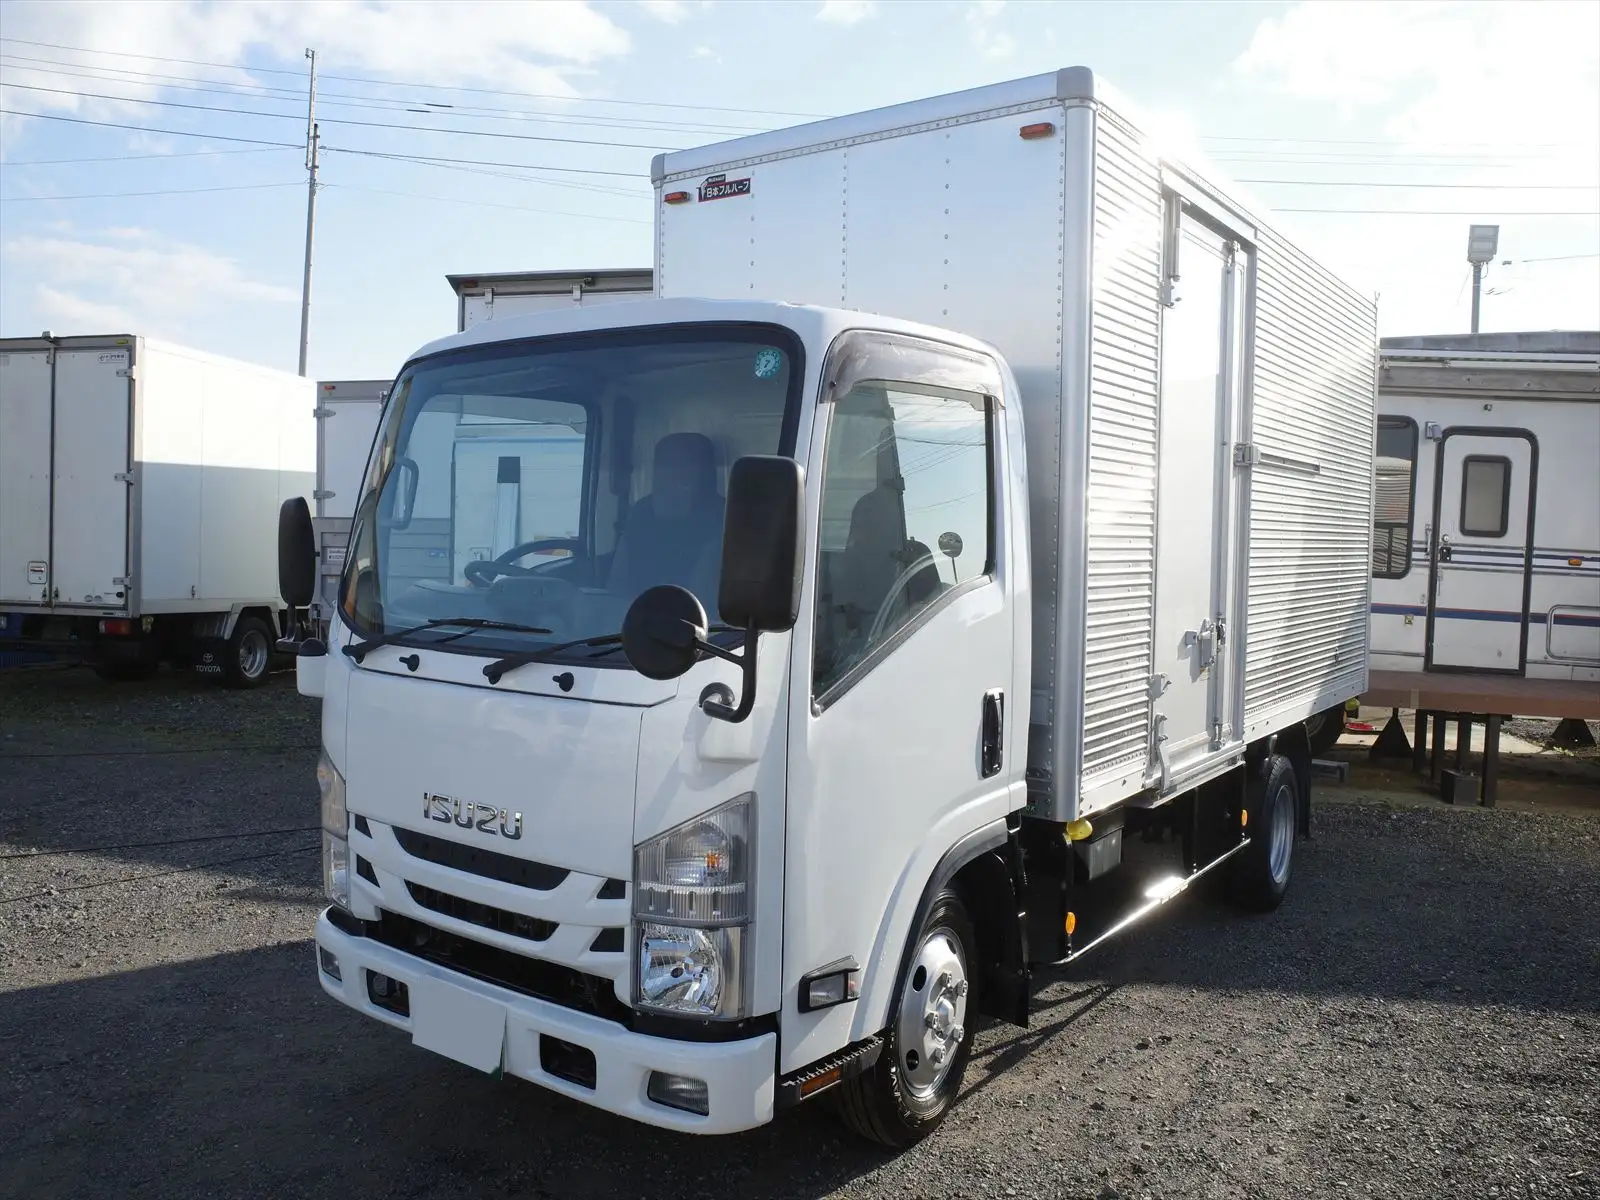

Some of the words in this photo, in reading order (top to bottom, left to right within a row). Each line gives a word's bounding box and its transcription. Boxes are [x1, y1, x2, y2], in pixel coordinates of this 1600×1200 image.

[706, 181, 749, 198] 日本フルハーフ
[195, 665, 221, 673] TOYOTA
[424, 791, 523, 840] ISUZU
